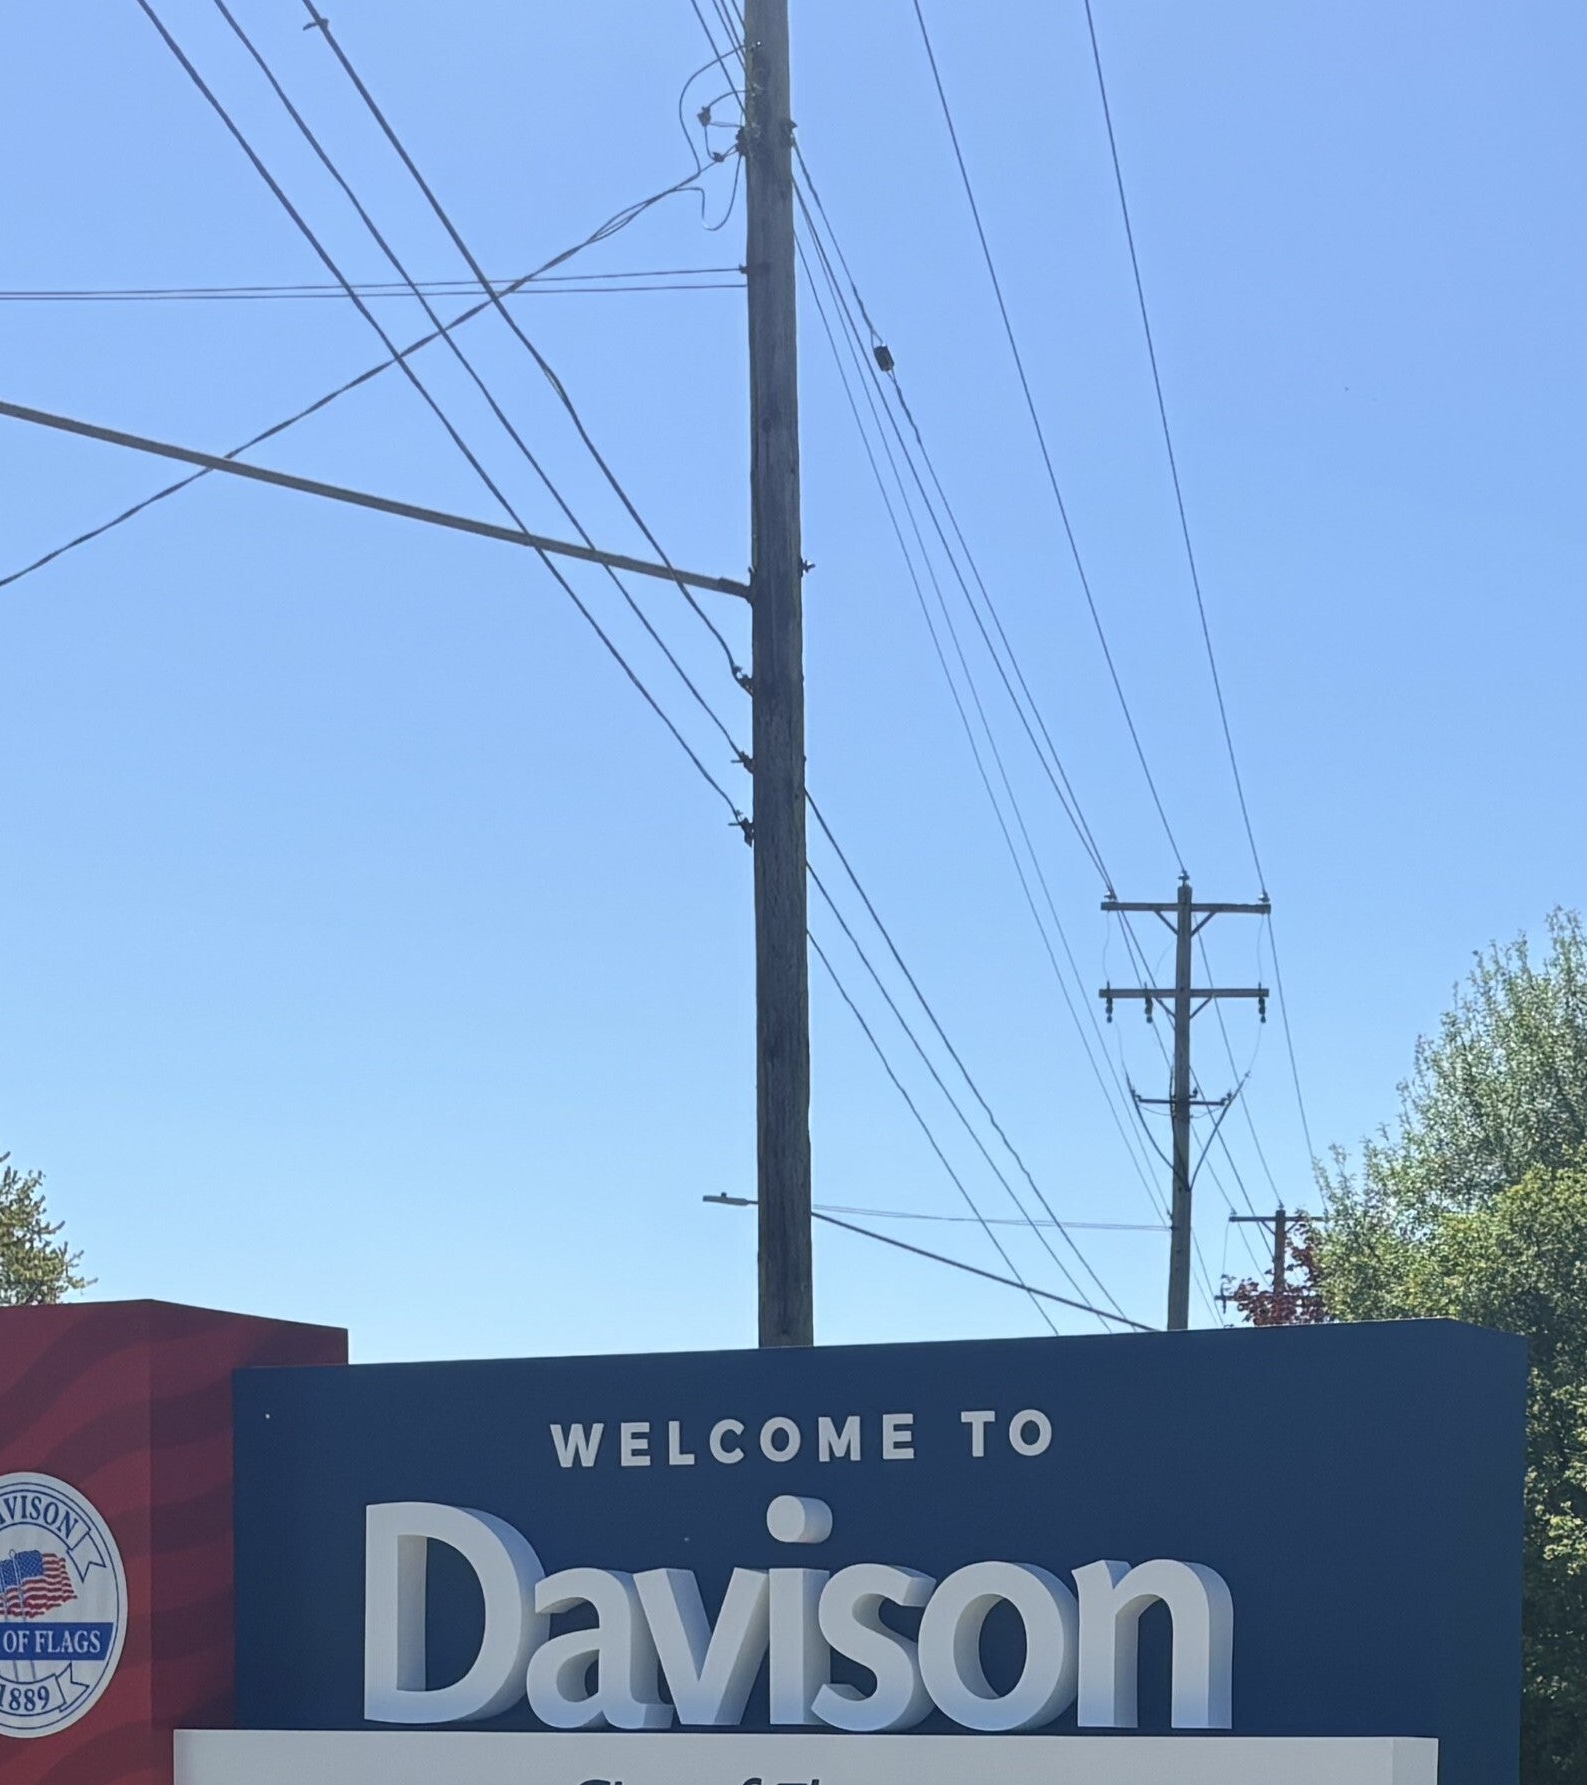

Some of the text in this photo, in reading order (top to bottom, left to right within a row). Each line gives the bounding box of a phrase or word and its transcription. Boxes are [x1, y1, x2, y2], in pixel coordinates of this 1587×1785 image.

[550, 1408, 1053, 1468] WELCOME TO
[3, 1630, 30, 1653] OF
[35, 1630, 101, 1653] FLAGS
[364, 1495, 1234, 1732] Davison
